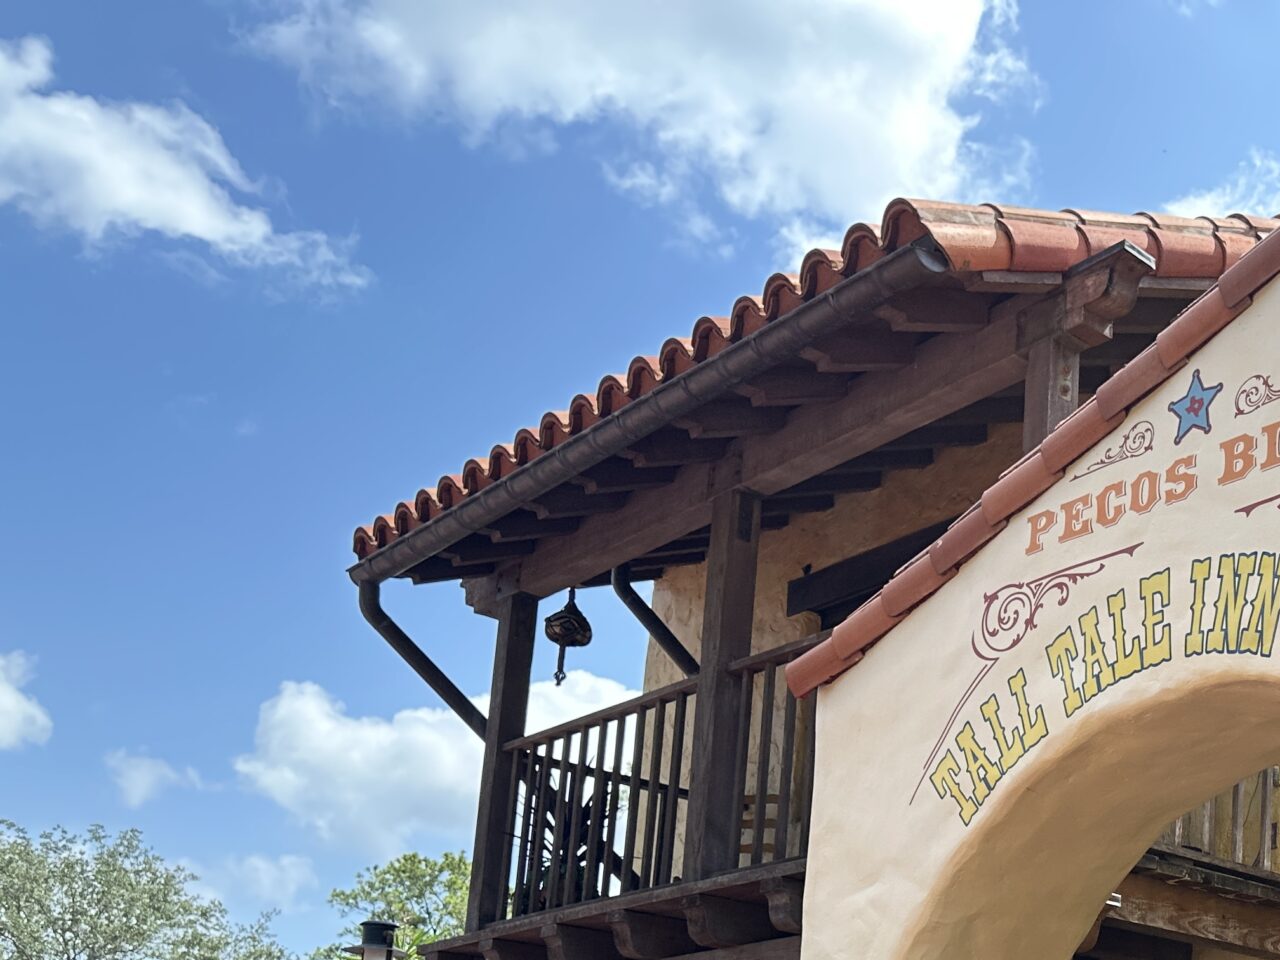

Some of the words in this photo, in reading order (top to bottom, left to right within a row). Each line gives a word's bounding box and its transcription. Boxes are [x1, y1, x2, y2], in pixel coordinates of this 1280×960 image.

[1025, 455, 1199, 556] PECOS
[930, 666, 1050, 827] TALL
[1045, 567, 1173, 719] TALE
